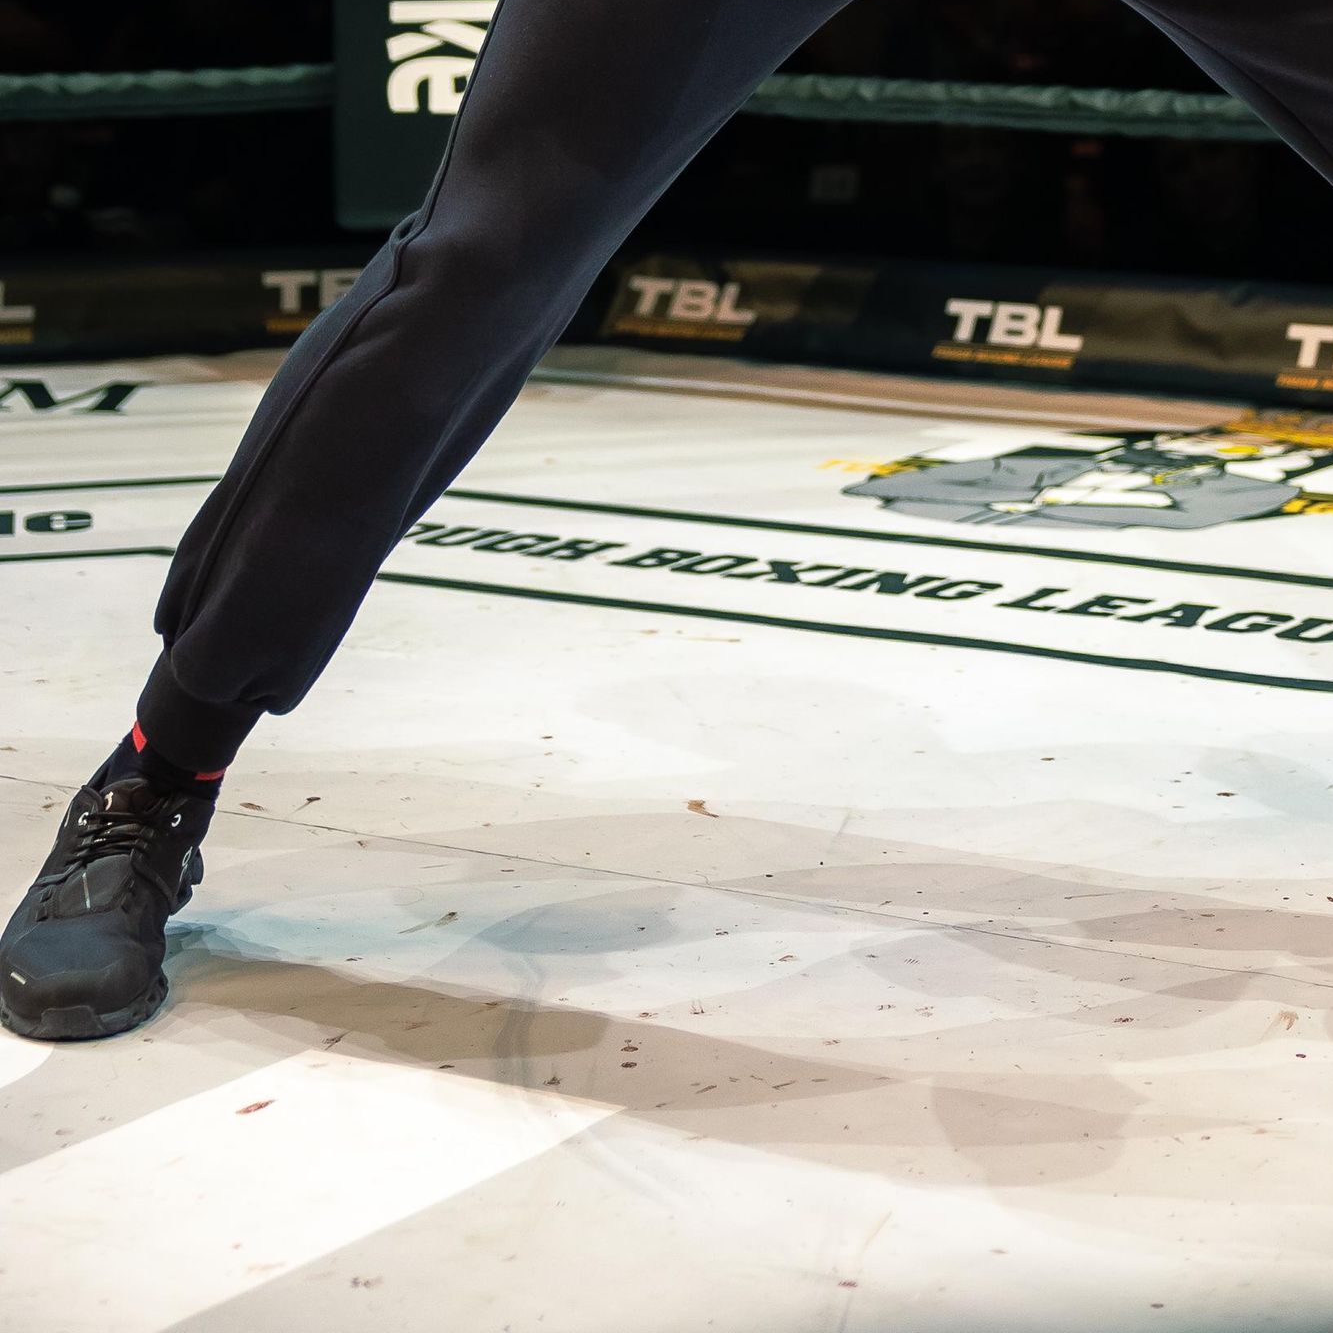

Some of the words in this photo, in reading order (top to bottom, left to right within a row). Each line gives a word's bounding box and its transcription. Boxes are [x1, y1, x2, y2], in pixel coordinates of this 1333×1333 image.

[627, 276, 757, 326] TBL
[944, 298, 1084, 352] TBL
[607, 547, 1002, 600] BOXING
